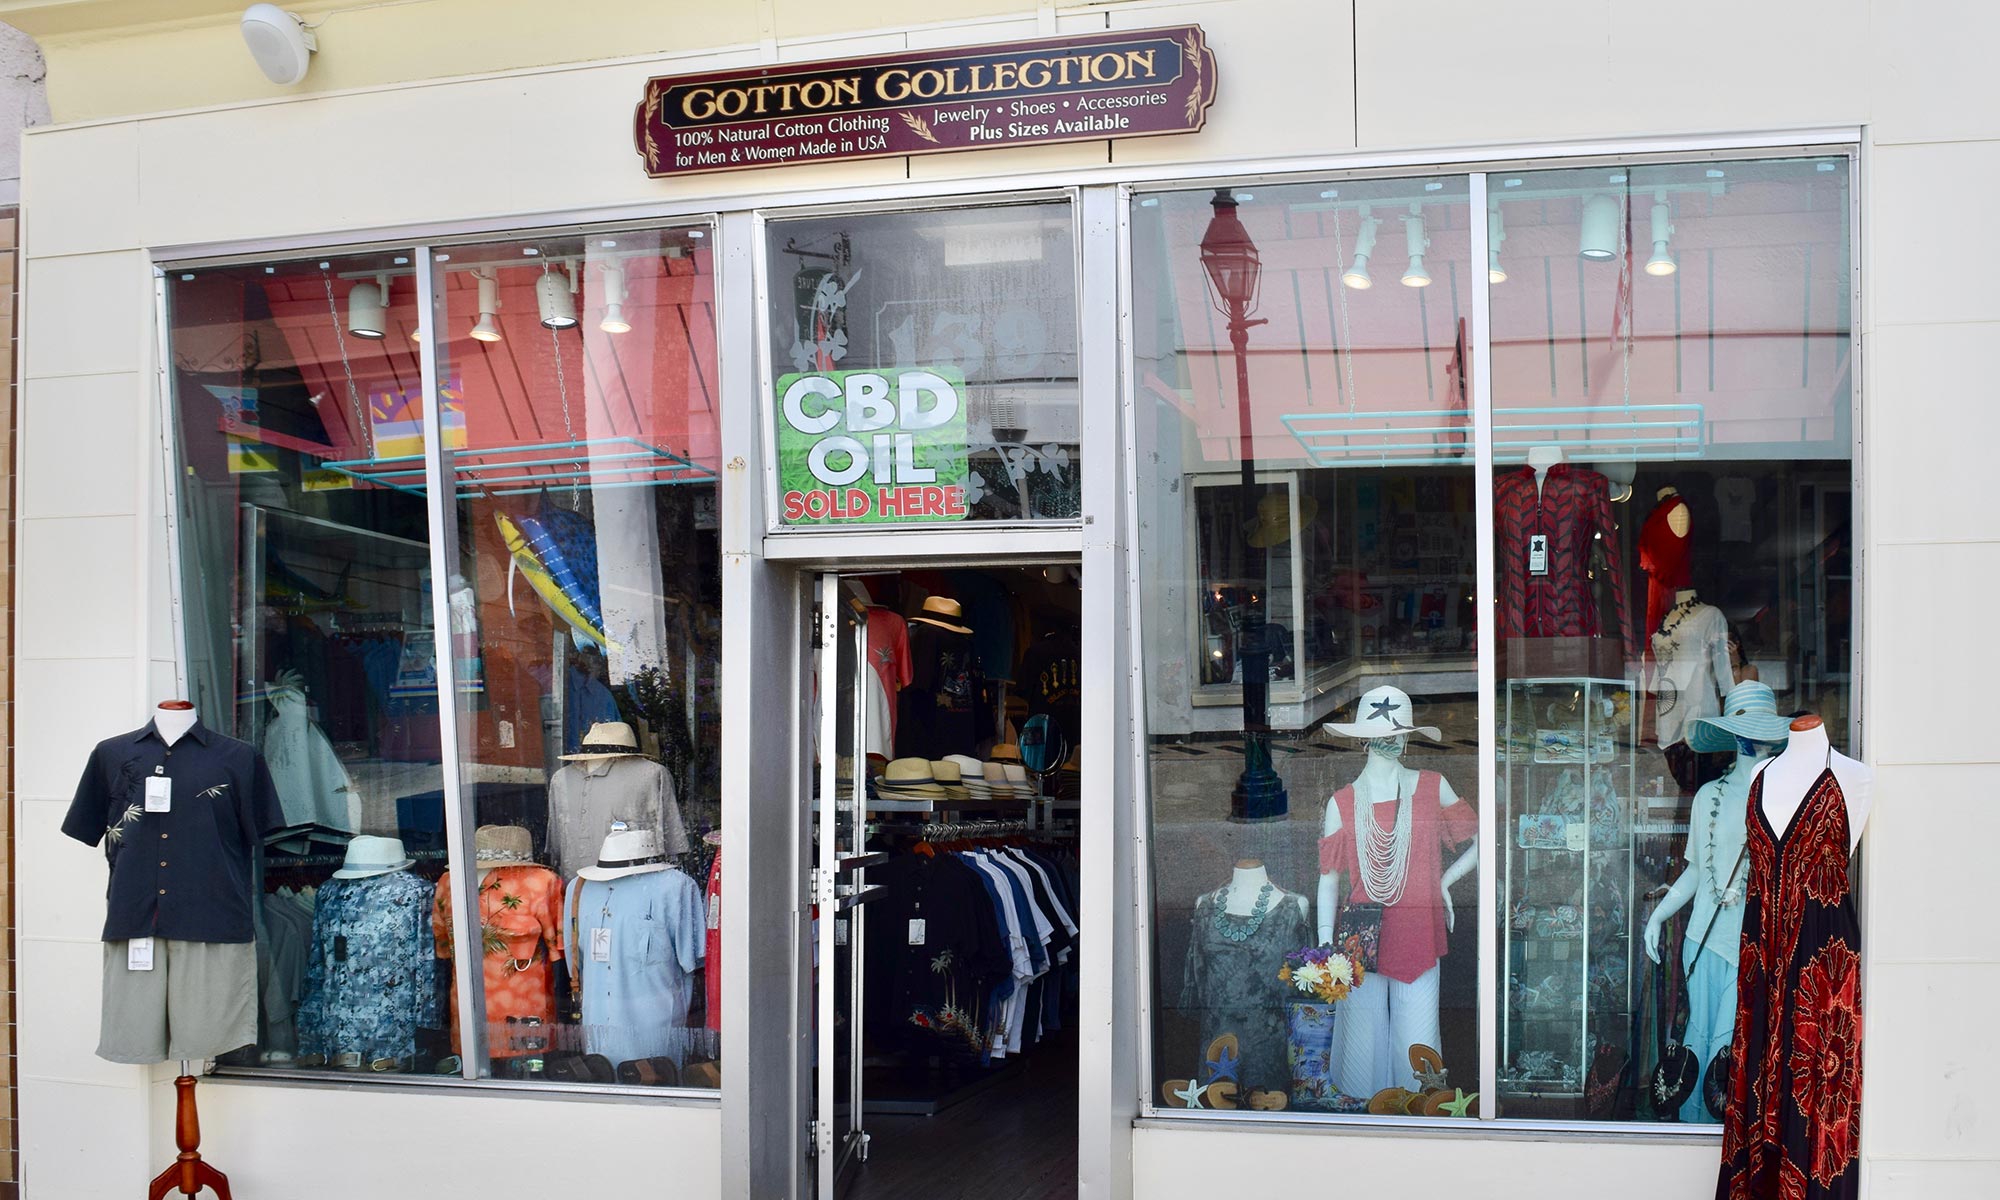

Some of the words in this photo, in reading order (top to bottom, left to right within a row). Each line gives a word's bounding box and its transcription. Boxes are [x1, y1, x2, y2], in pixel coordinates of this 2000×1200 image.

[933, 104, 990, 126] Jewelry
[1010, 100, 1056, 117] Shoes
[1076, 91, 1168, 111] Accessories
[674, 129, 713, 147] 100%
[718, 124, 770, 142] Natural
[774, 120, 823, 138] Cotton
[828, 115, 890, 134] Clothing
[970, 124, 1003, 141] Plus
[1008, 121, 1049, 138] Sizes
[1054, 112, 1130, 134] Available
[676, 152, 693, 167] for
[697, 150, 726, 165] Men
[731, 147, 741, 162] &
[745, 145, 795, 161] Women
[800, 139, 837, 156] Made
[841, 137, 853, 152] in
[858, 135, 887, 151] USA
[782, 371, 959, 435] CBD
[807, 432, 937, 487] OIL
[782, 488, 871, 521] SOLD
[878, 485, 967, 518] HERE
